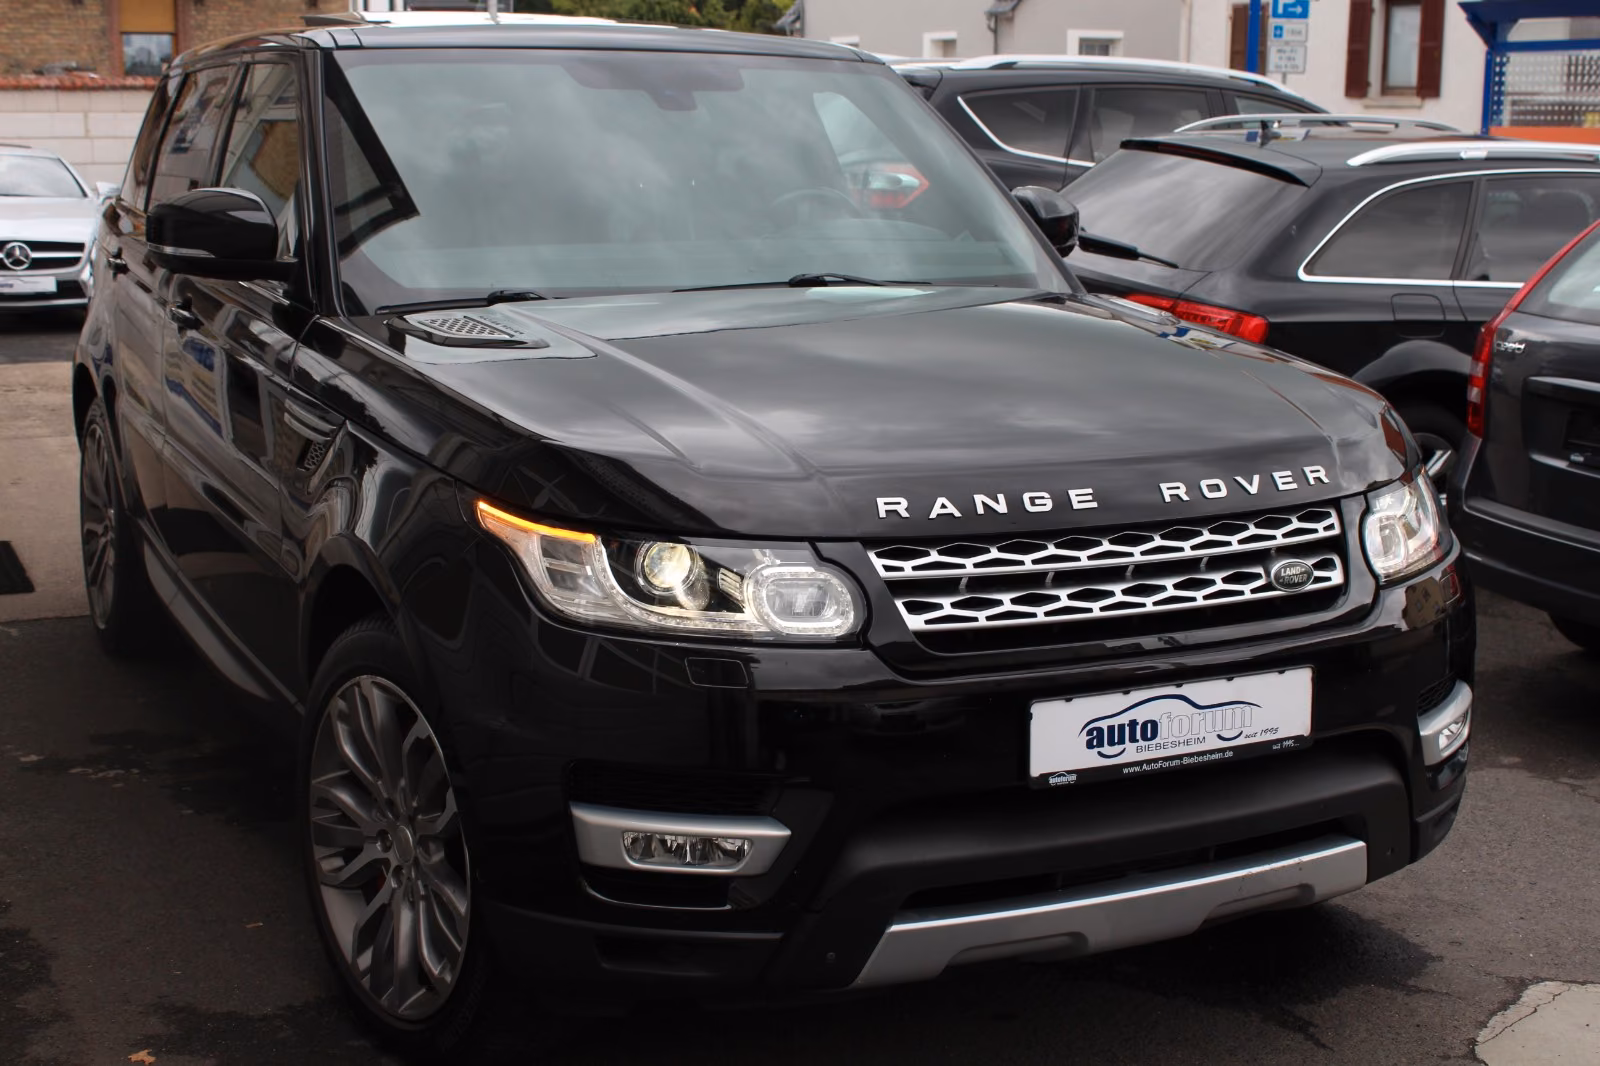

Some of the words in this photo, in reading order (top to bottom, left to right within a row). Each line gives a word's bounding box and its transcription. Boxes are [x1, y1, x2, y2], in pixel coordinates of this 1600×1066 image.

[876, 488, 1099, 520] RANGE
[1158, 465, 1331, 503] ROVER
[1281, 566, 1302, 577] LAND
[1283, 573, 1308, 584] ROVER
[1085, 706, 1253, 750] autoforum
[1260, 727, 1280, 737] 1995
[1135, 736, 1206, 754] BIEBESHEIM
[1122, 750, 1234, 775] www.AutoForum-Biebesheim.de
